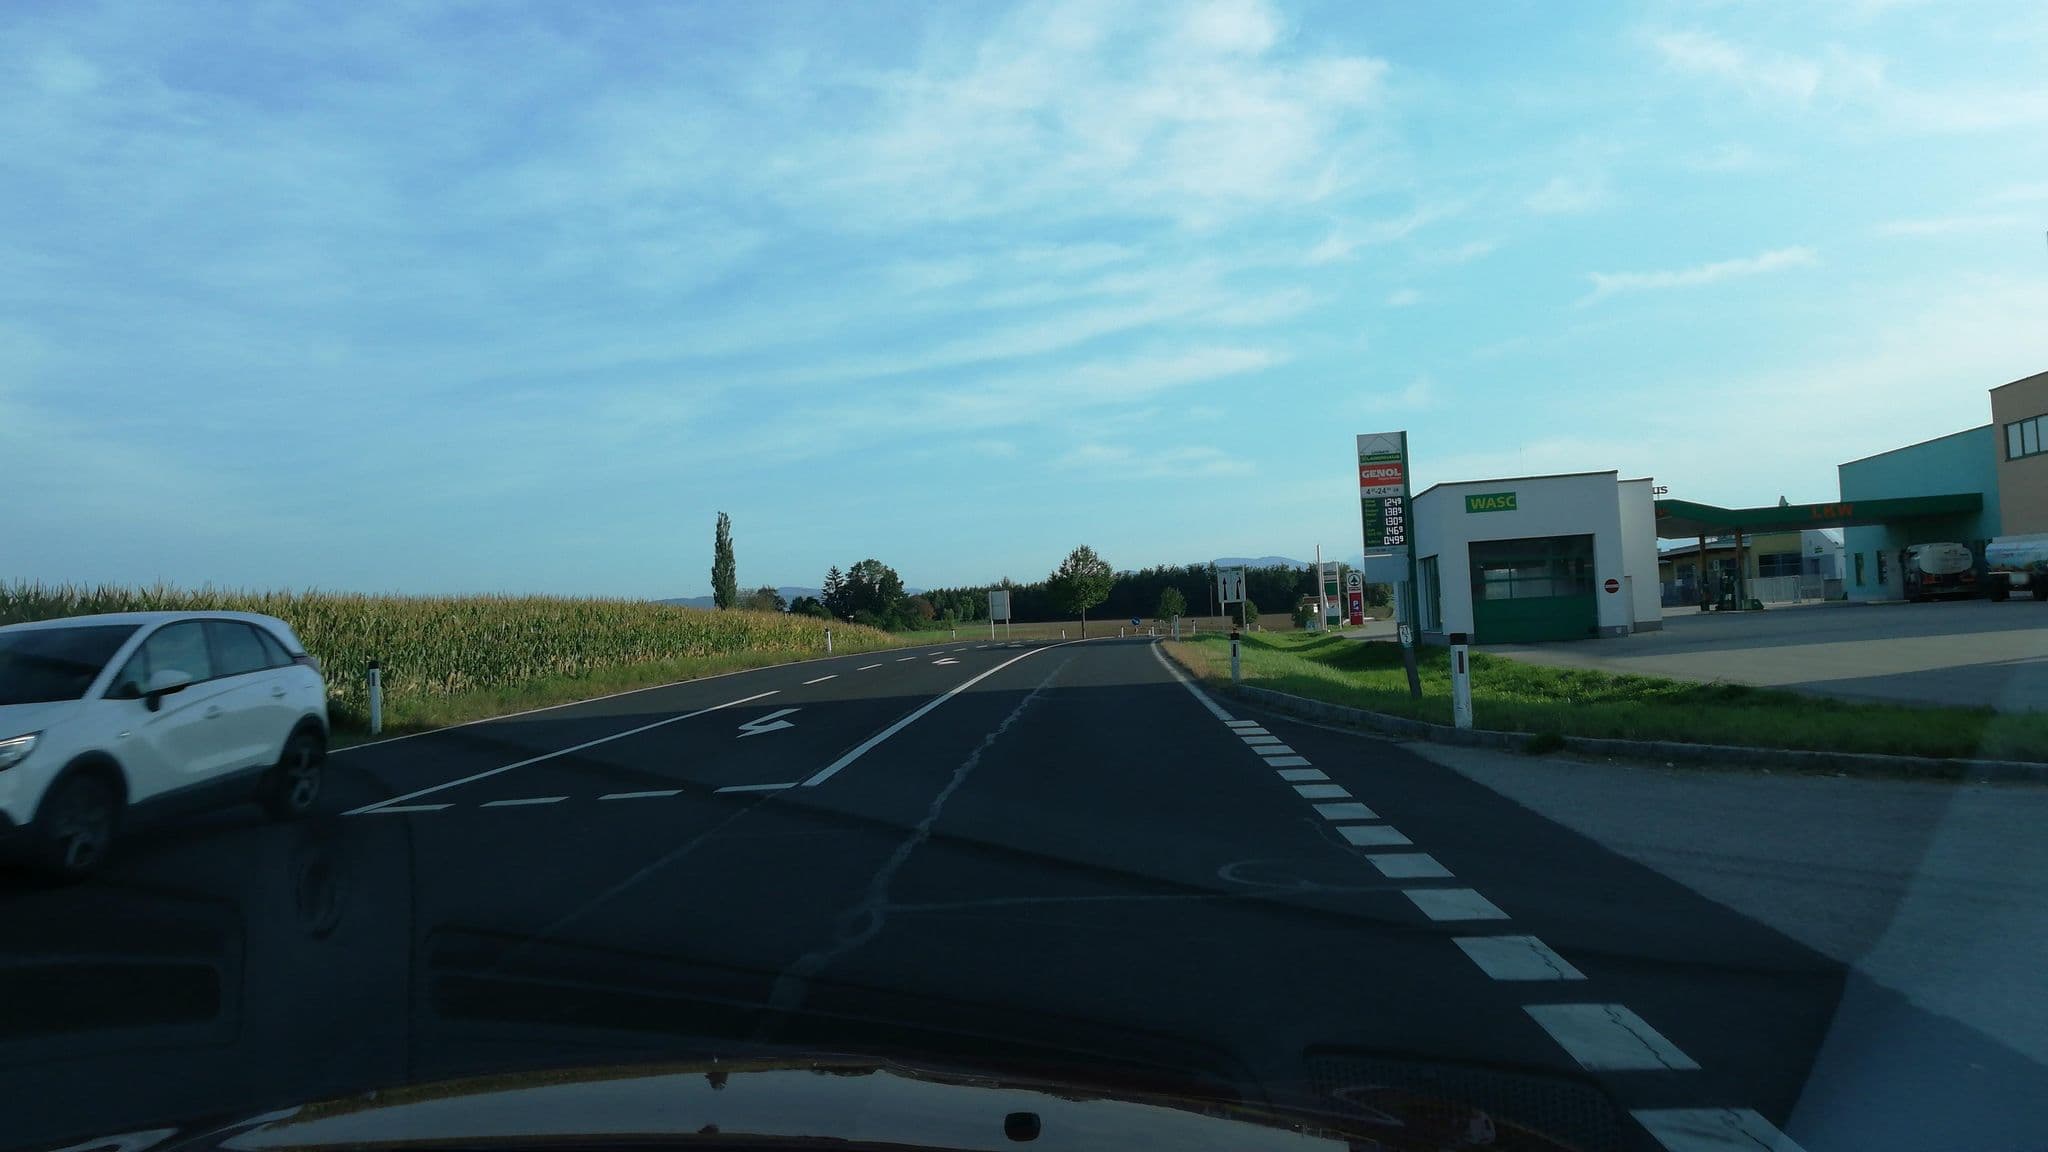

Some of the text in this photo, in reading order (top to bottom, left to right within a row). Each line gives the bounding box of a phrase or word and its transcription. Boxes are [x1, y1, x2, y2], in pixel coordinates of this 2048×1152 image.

[1362, 468, 1402, 478] GENOL
[1471, 496, 1515, 509] WASC
[1812, 505, 1853, 520] LKW
